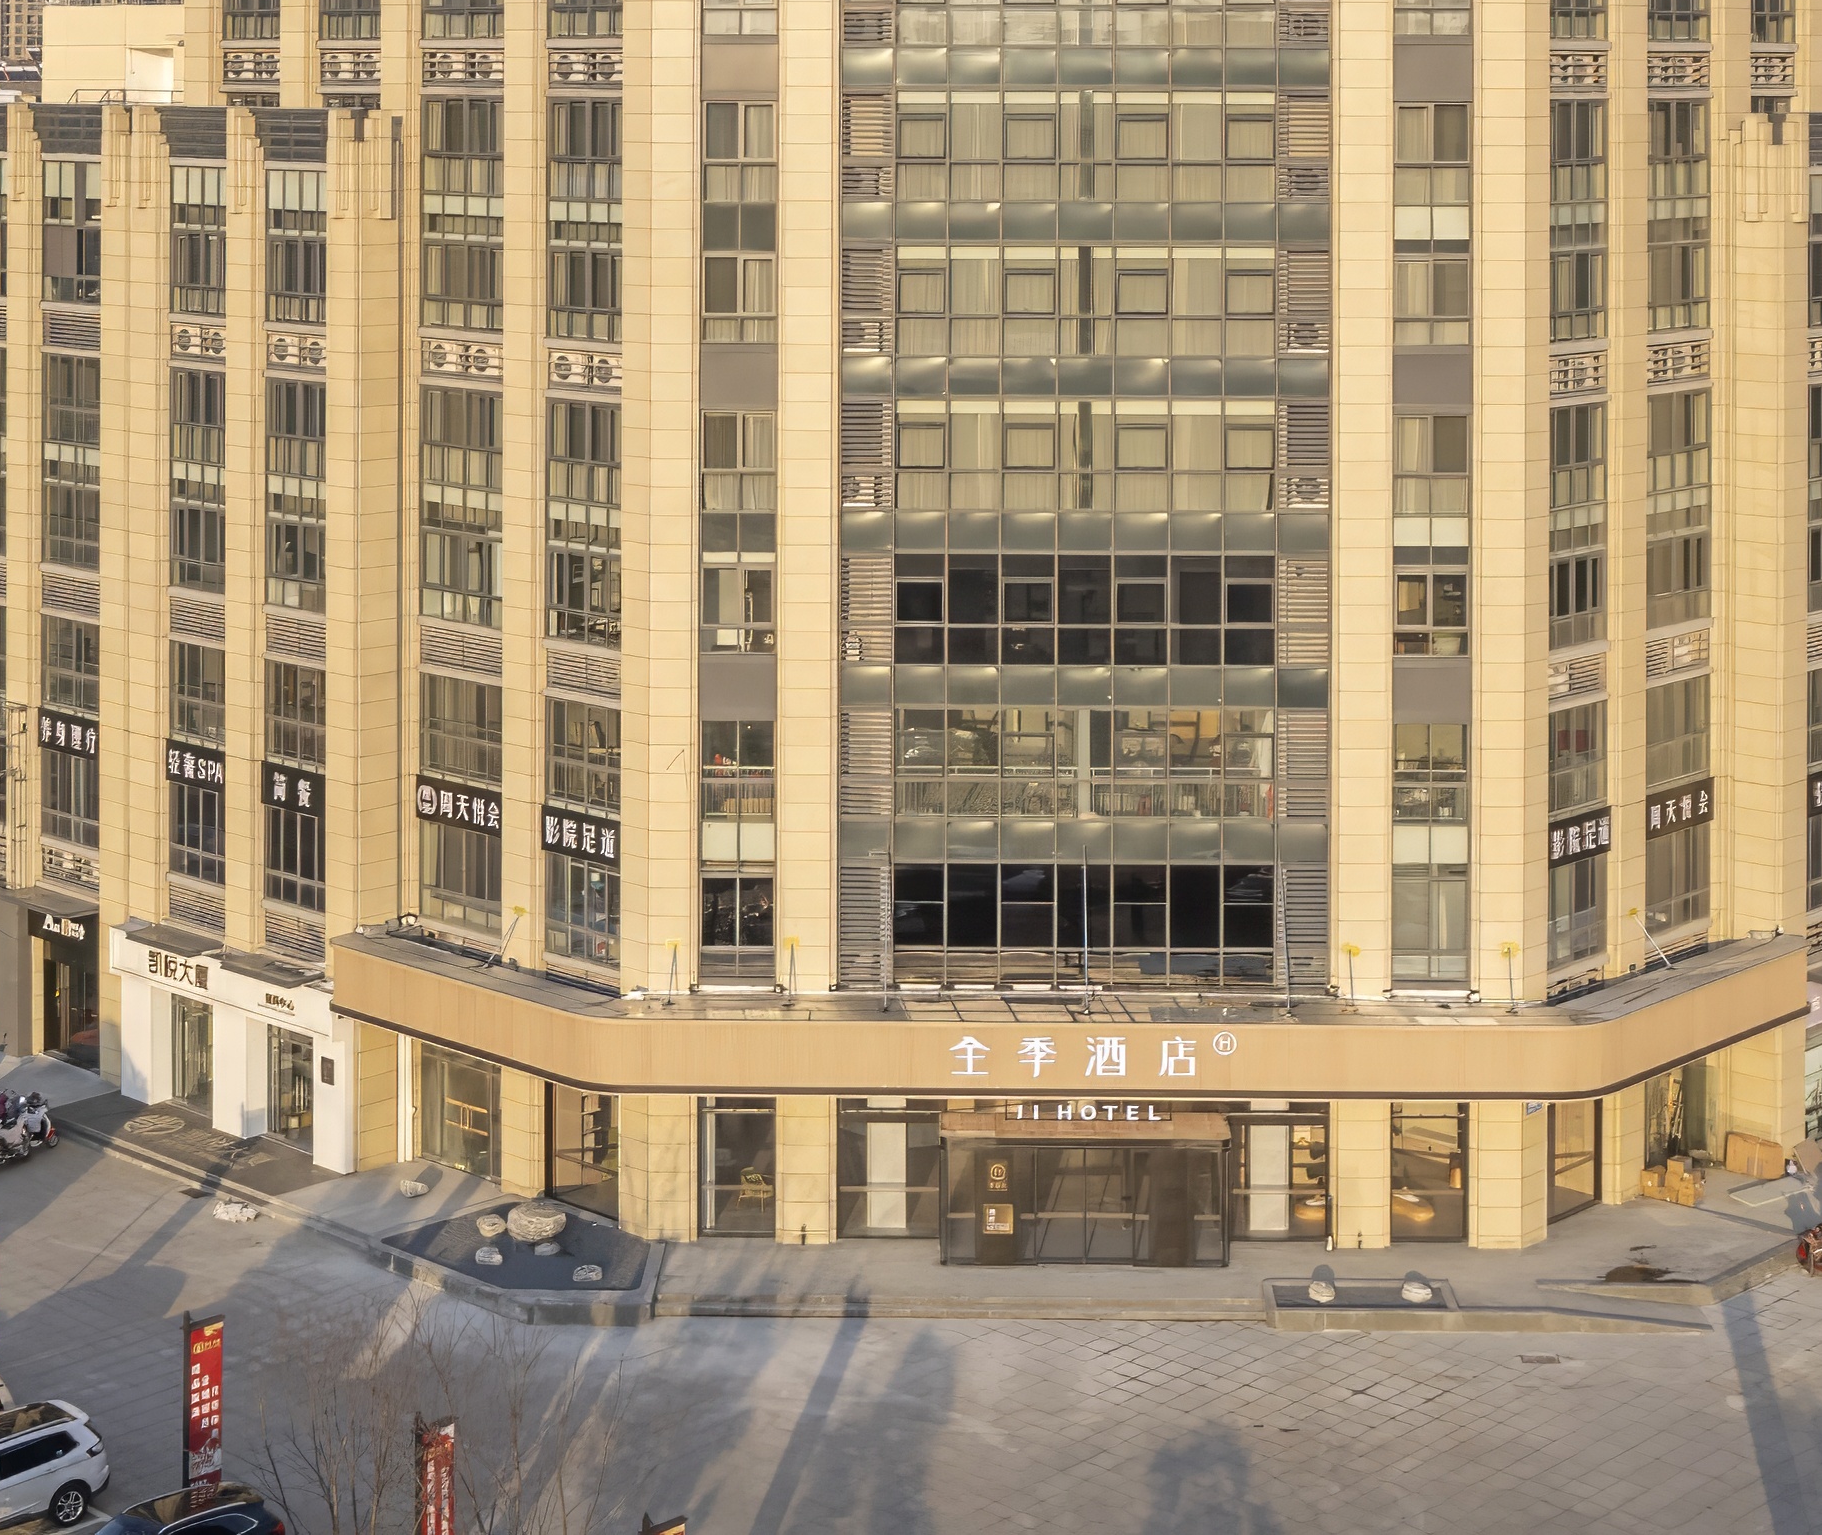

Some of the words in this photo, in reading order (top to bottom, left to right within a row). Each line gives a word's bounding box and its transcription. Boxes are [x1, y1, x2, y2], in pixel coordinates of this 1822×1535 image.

[544, 815, 616, 859] 影院足道
[949, 1036, 1197, 1078] 全季酒店
[1057, 1104, 1163, 1121] HOTEL
